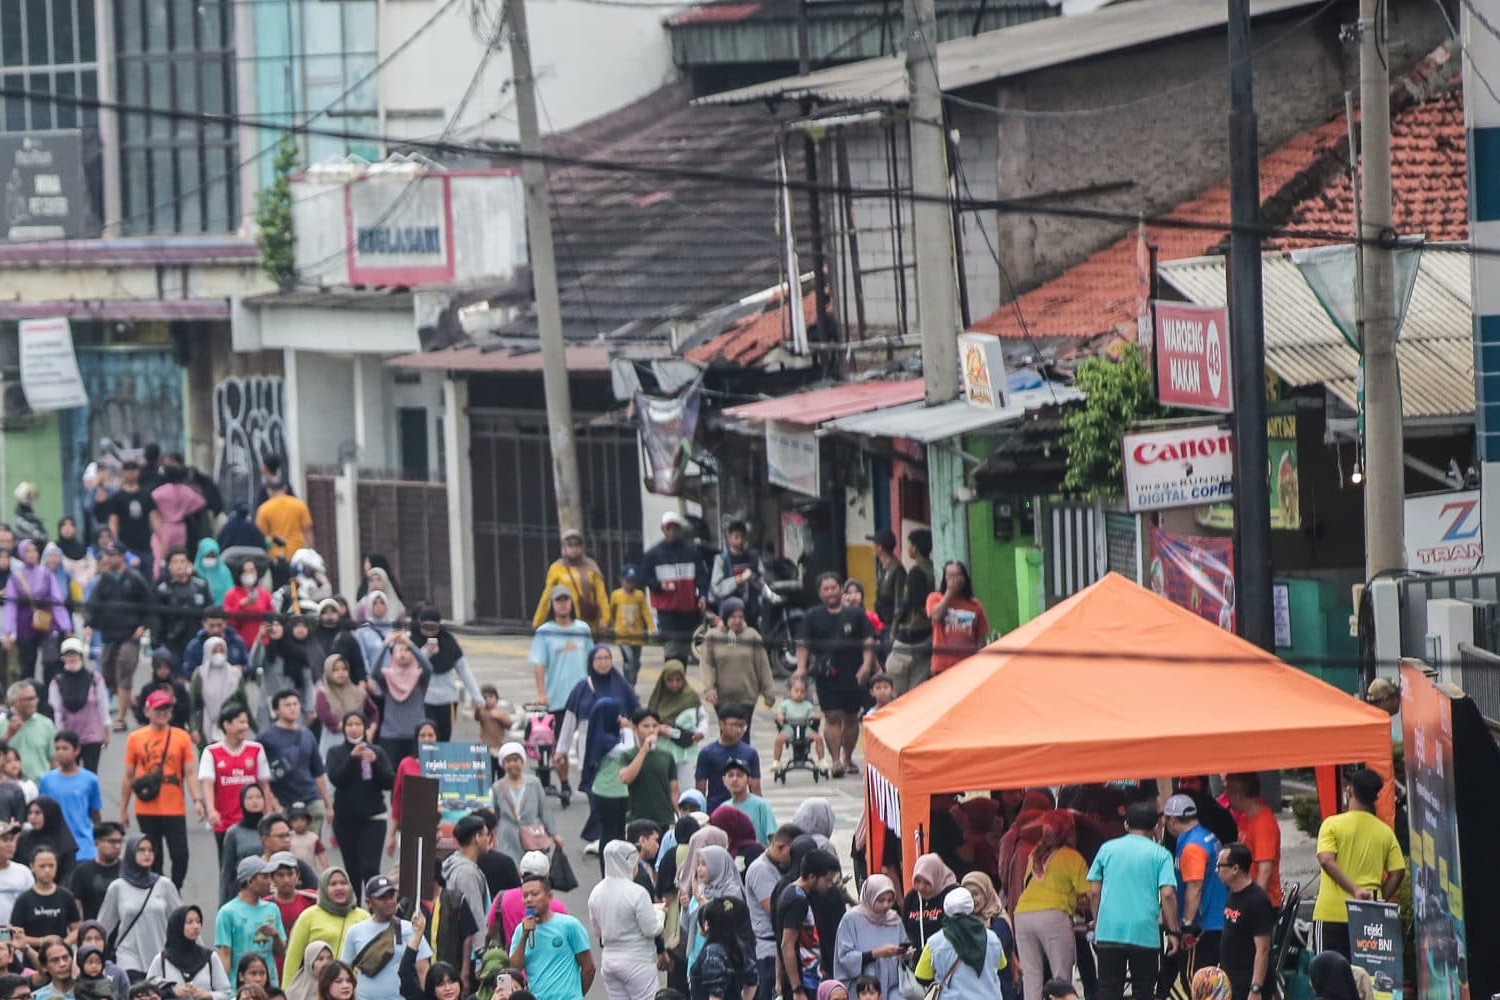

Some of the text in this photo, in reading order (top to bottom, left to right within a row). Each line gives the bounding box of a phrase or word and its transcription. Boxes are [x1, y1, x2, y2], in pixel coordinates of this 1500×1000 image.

[1162, 318, 1204, 355] WAROENG
[1208, 341, 1221, 376] 48
[1170, 357, 1201, 393] MAKAN
[1133, 434, 1234, 465] Canon
[1135, 474, 1234, 493] imageRUNNE
[1138, 486, 1189, 506] DIGITAL
[1363, 922, 1383, 940] rejeki
[1378, 941, 1393, 953] BNI
